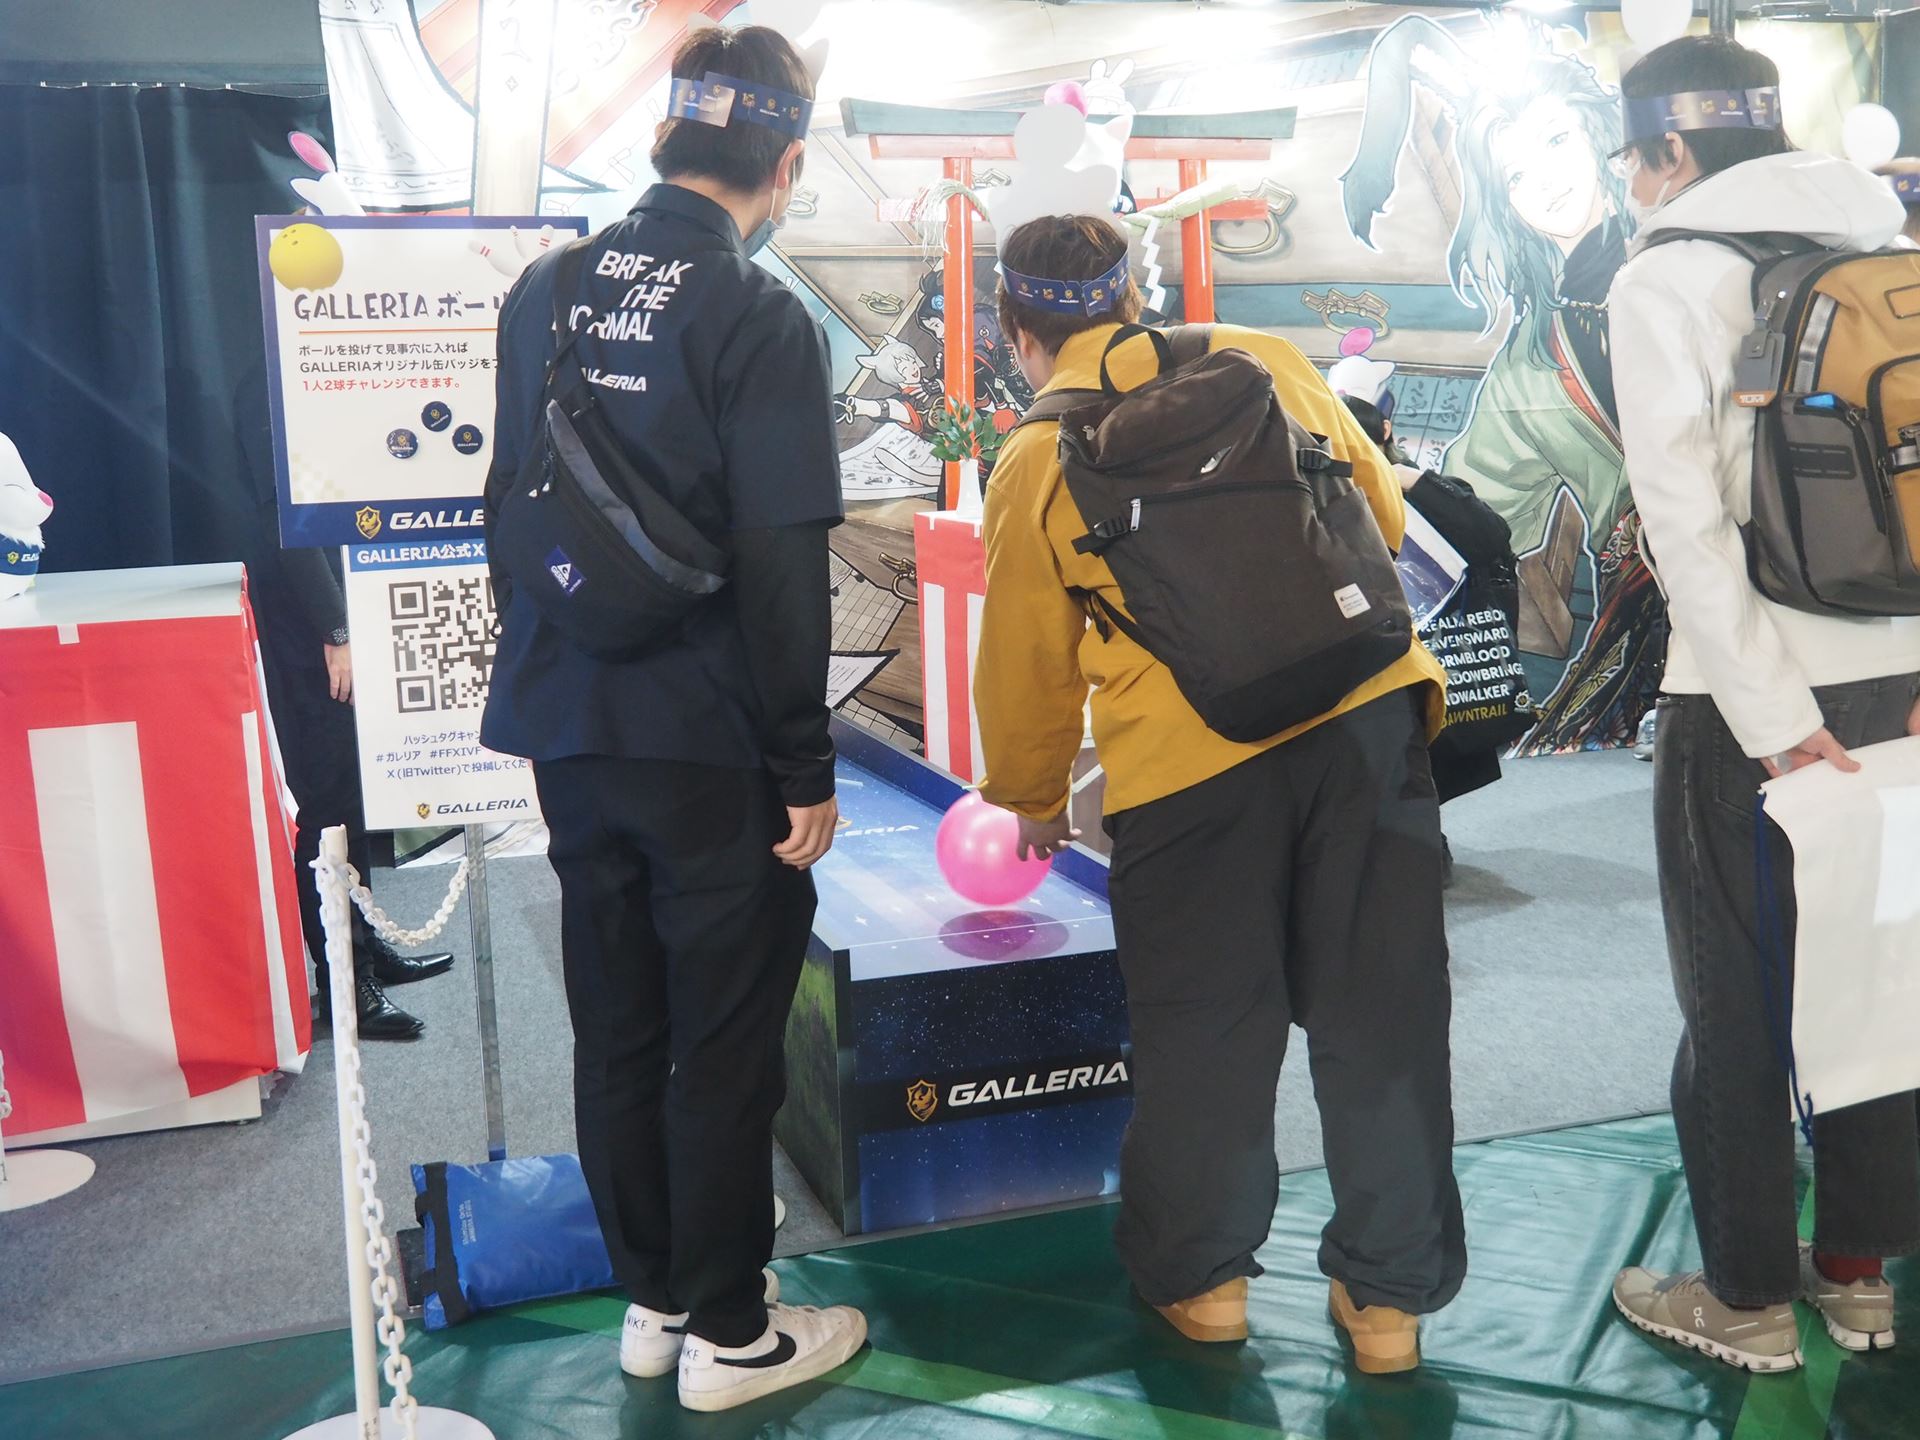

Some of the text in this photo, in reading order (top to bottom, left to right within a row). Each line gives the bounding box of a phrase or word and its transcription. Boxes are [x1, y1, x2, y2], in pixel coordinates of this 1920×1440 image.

[294, 292, 429, 321] GALLERIA
[620, 284, 676, 310] THE
[299, 342, 468, 357] ボールを投げて見事穴に入れば
[389, 509, 484, 530] GALLE
[436, 798, 529, 815] GALLERIA
[948, 1061, 1129, 1107] GALLERIA
